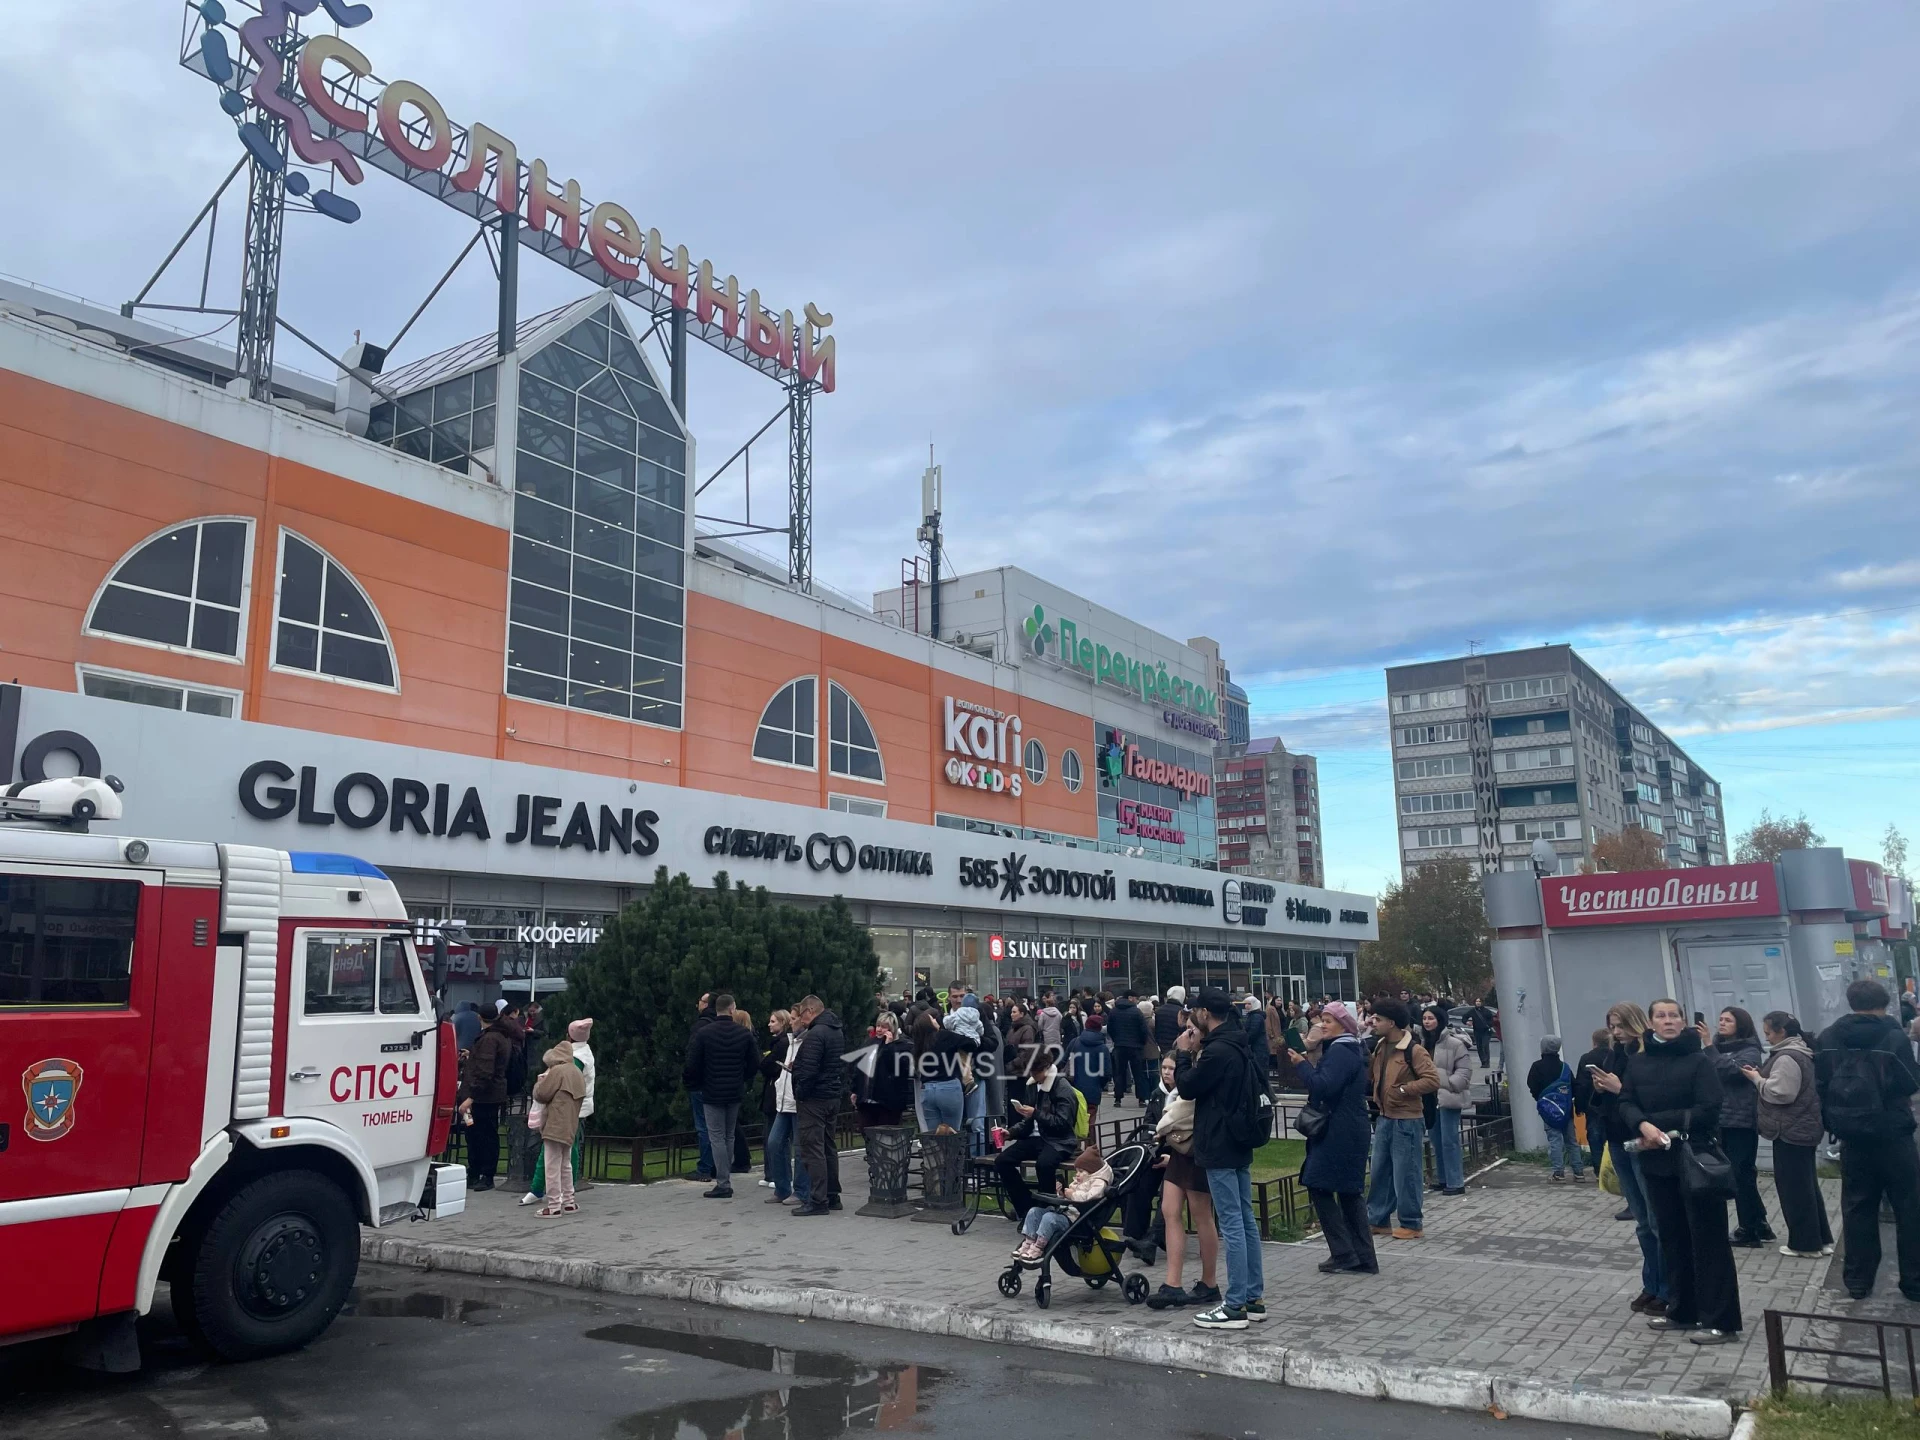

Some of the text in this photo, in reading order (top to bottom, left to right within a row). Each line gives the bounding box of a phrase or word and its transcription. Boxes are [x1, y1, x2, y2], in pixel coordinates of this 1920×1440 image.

[1060, 617, 1218, 719] Перекрёсток
[945, 695, 1022, 767] kari
[1124, 743, 1211, 801] Галамарт
[238, 760, 660, 856] GLORIA JEANS
[1139, 803, 1174, 823] МАГНИТ
[704, 825, 803, 862] СИБИРЬ
[858, 844, 934, 875] ОПТИКА
[1139, 823, 1186, 845] КОСМЕТИК
[960, 856, 1117, 901] 585 ЗОЛОТОЙ
[1560, 878, 1759, 911] ЧестноДеньги
[1008, 940, 1088, 960] SUNLIGHT
[383, 1044, 409, 1053] 43253
[329, 1061, 421, 1103] СПСЧ
[362, 1109, 413, 1127] ТЮМЕНЬ
